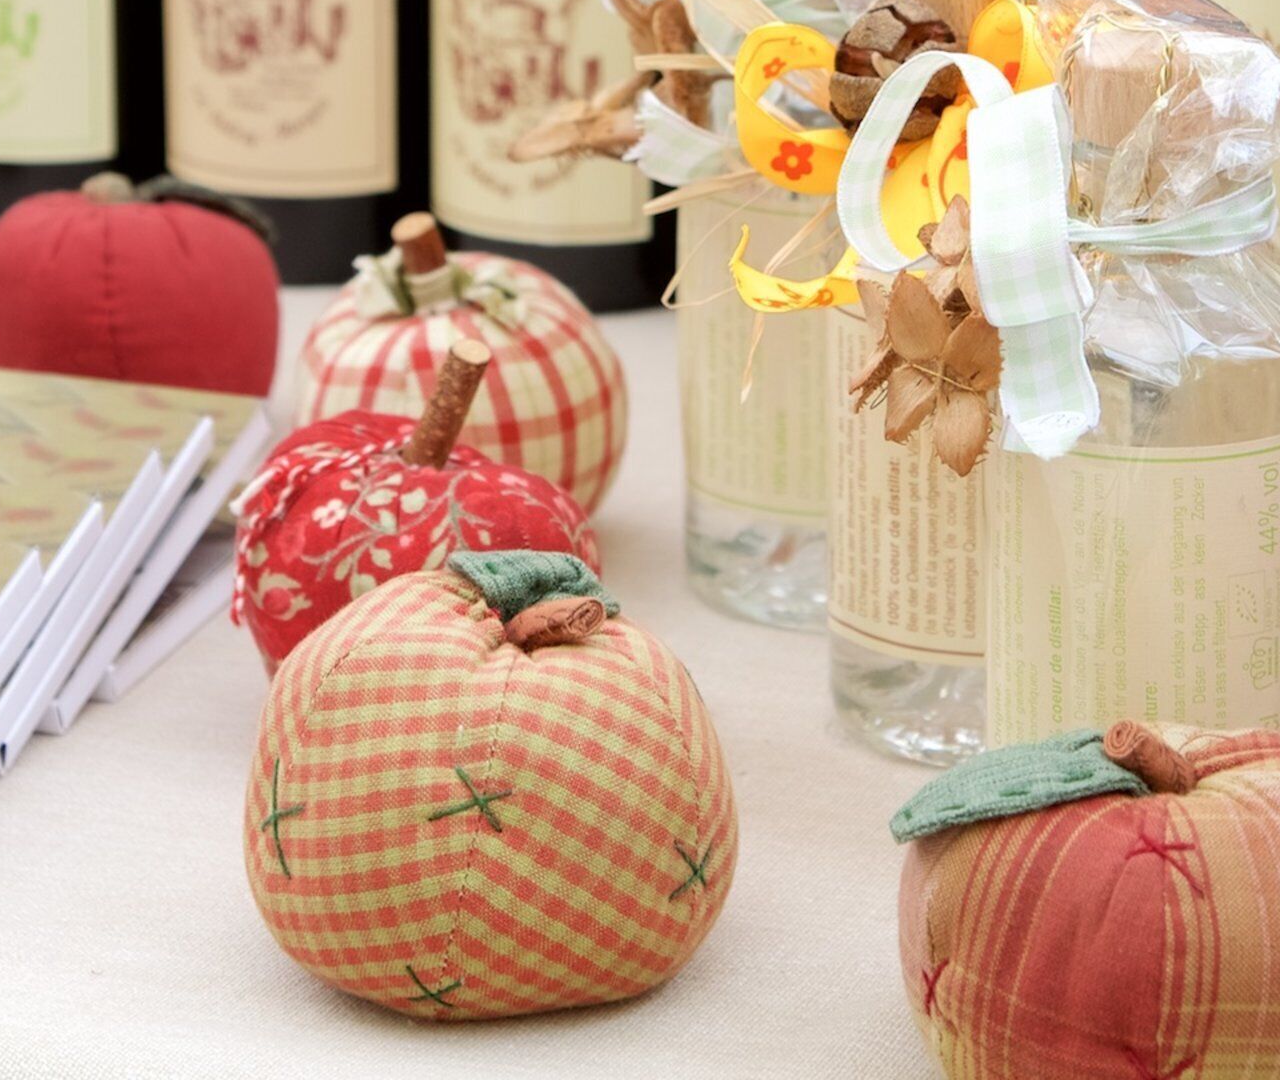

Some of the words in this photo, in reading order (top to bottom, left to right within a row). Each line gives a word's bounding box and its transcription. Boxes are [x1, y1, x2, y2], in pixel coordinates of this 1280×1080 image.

[1258, 461, 1280, 497] vol
[1191, 476, 1206, 521] Zocker
[888, 519, 900, 537] de
[1073, 520, 1086, 536] de
[1257, 503, 1280, 555] 44%
[889, 541, 900, 584] coeur
[1191, 534, 1206, 565] keen
[1172, 576, 1185, 596] der
[1194, 578, 1206, 601] ass
[1049, 585, 1063, 649] distillat:
[1174, 601, 1185, 624] aus
[1049, 653, 1062, 674] de
[1171, 631, 1186, 680] exklusiv
[1050, 678, 1063, 723] coeur
